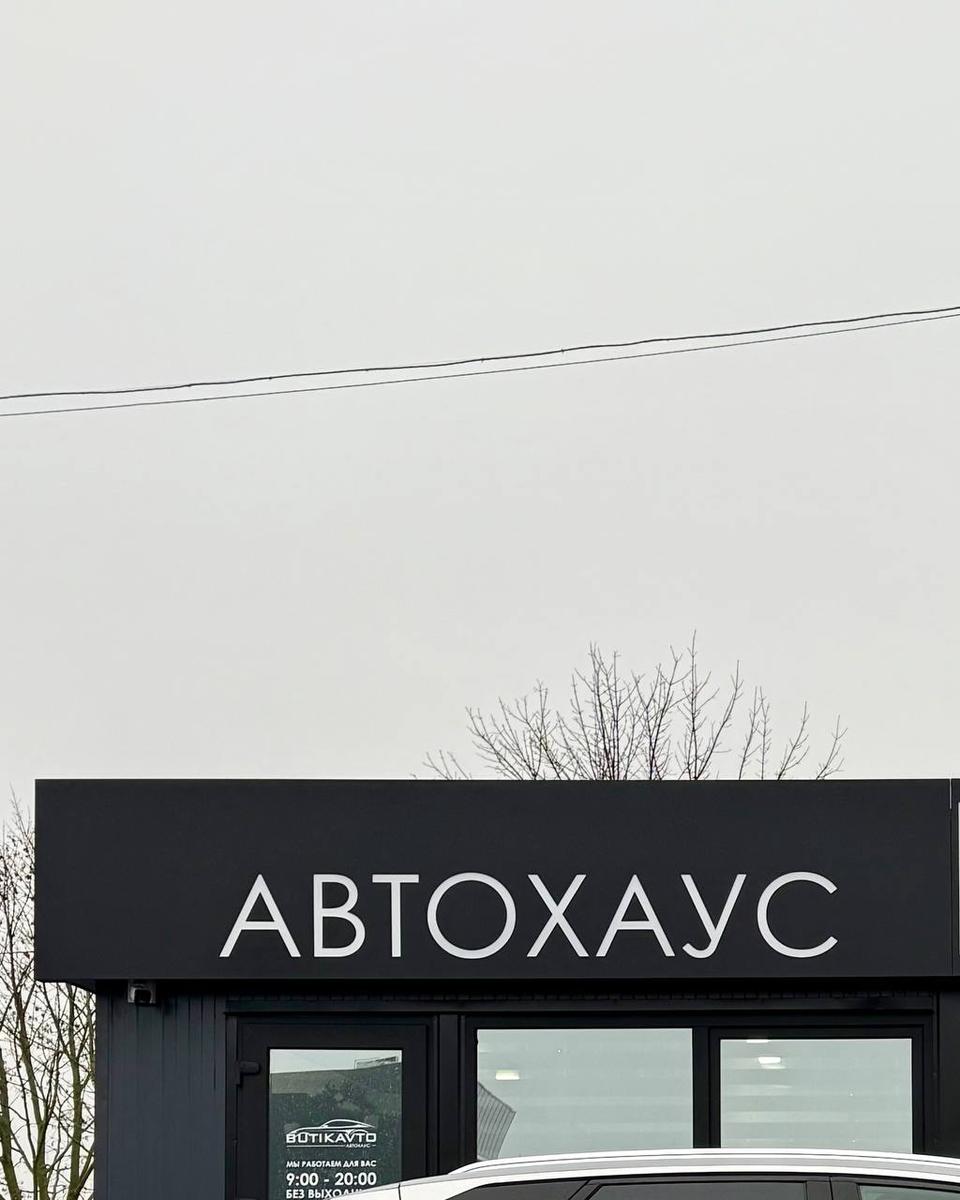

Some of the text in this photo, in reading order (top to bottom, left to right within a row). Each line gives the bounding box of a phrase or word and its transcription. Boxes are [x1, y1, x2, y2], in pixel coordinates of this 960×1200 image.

[219, 871, 838, 959] АВТОХАУС
[286, 1133, 376, 1143] BUTIKAVTO
[286, 1173, 319, 1186] 9:00
[335, 1172, 376, 1186] 20:00
[286, 1189, 304, 1199] БЕЗ
